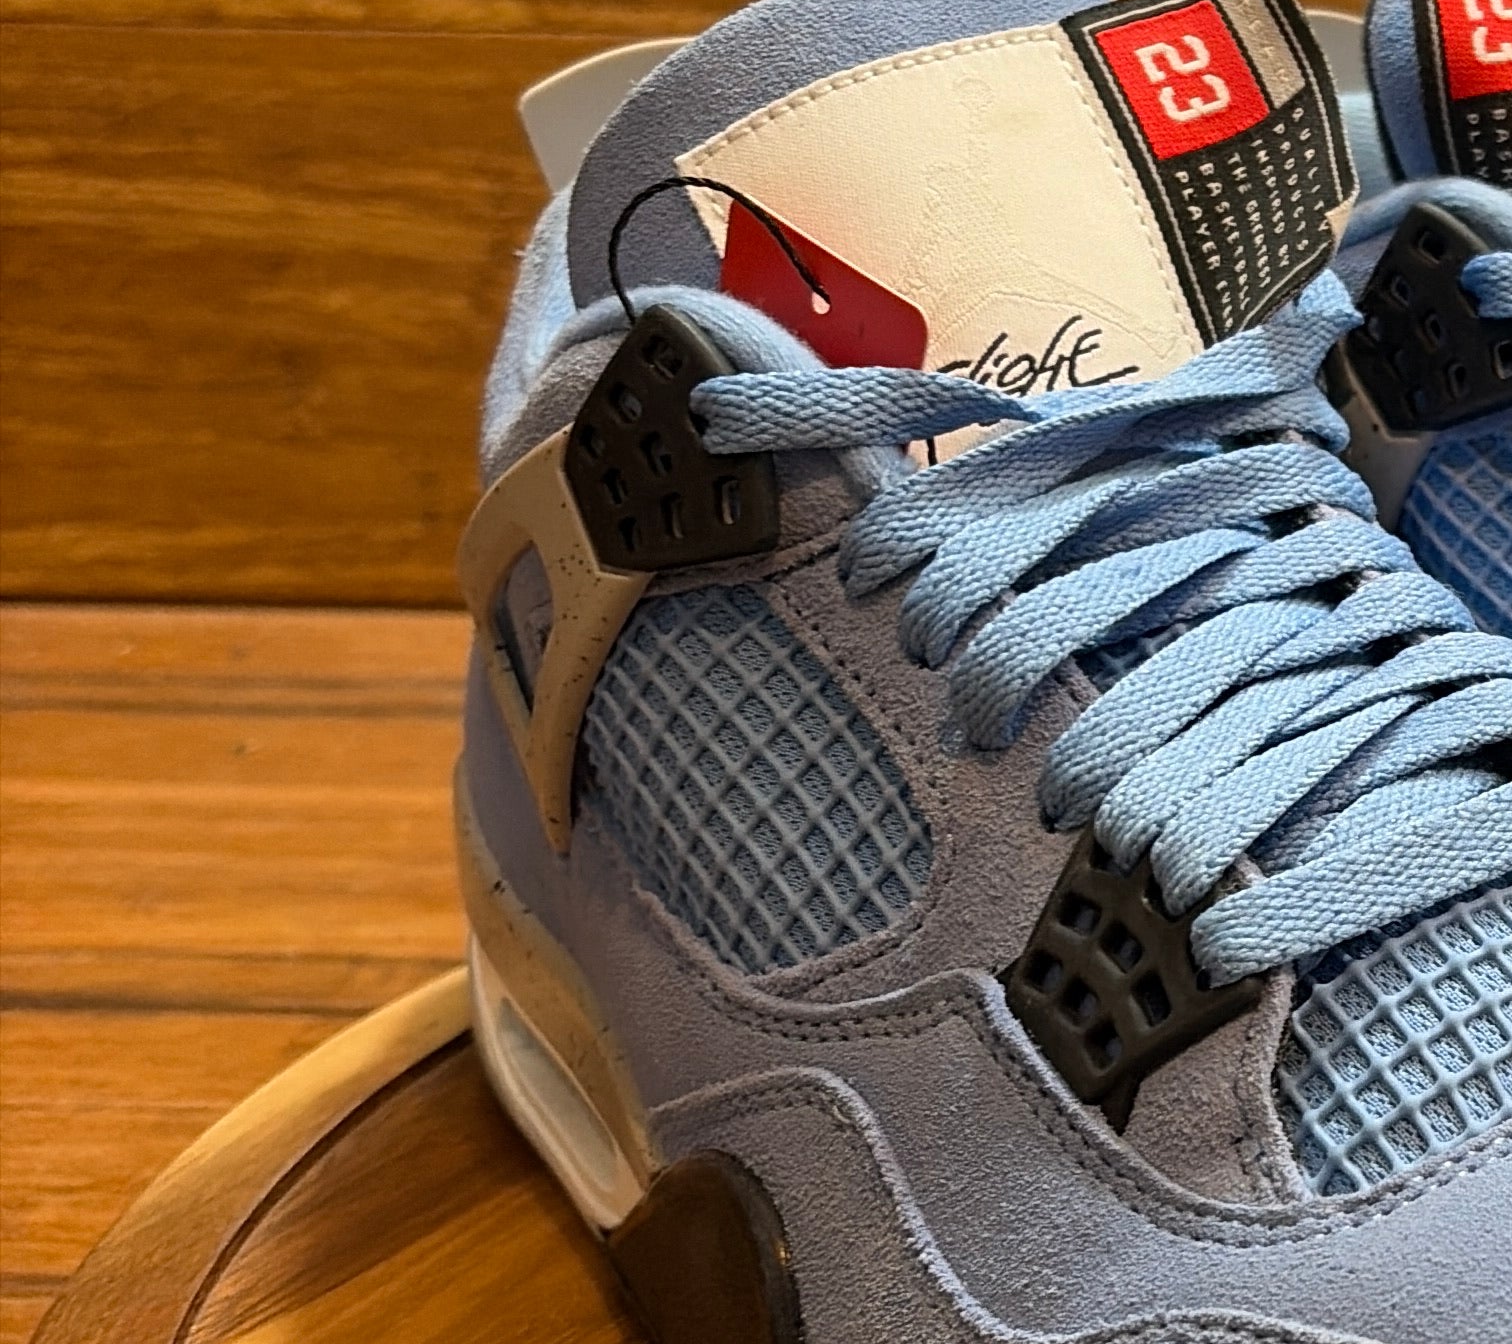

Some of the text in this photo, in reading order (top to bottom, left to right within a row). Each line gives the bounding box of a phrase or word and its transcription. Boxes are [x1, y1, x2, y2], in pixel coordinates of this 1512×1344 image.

[1134, 34, 1232, 123] 23
[1174, 170, 1222, 271] PLAYER
[1227, 151, 1272, 289] THE GREATEST
[1250, 138, 1290, 269] INSPIRED BY
[1273, 122, 1309, 252] PRODUCTS
[1291, 107, 1332, 233] QUALITY
[1198, 161, 1250, 311] BASKETBALL
[935, 314, 1141, 399] light
